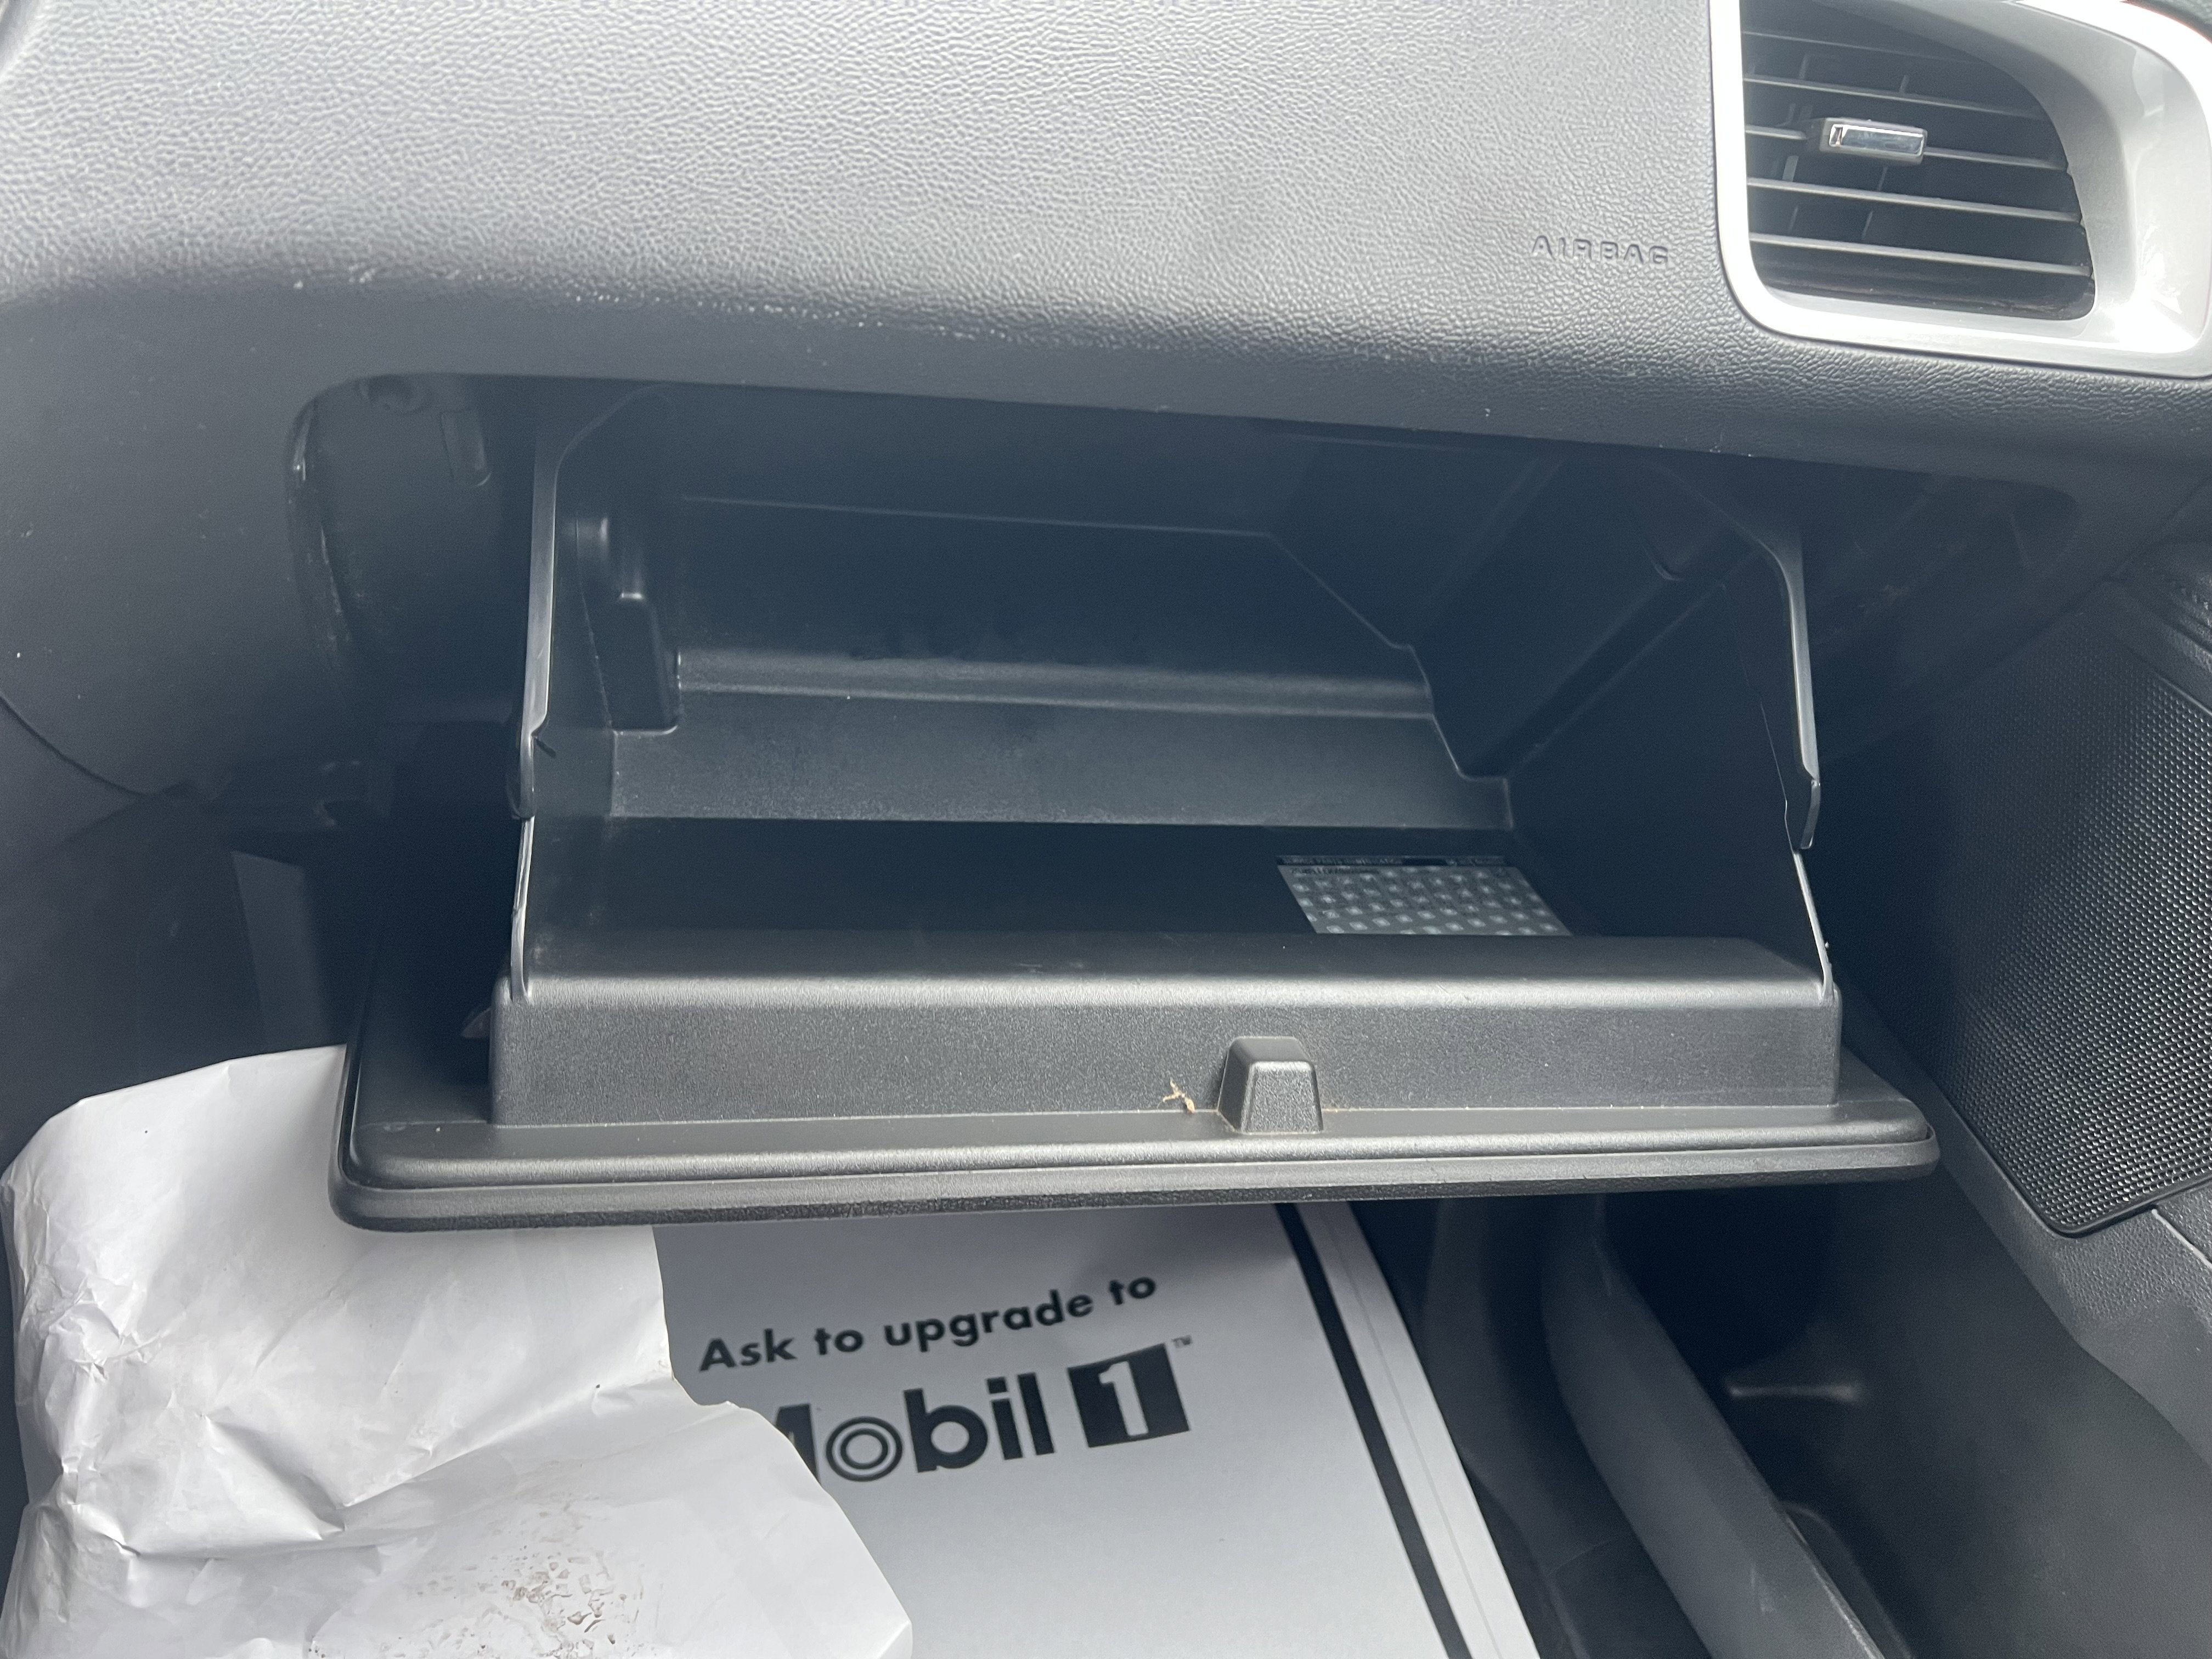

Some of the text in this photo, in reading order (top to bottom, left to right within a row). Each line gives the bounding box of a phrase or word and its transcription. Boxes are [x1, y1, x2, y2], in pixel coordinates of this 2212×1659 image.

[1532, 235, 1668, 264] AIRBAG
[698, 1276, 1157, 1372] Ask to upgrade to
